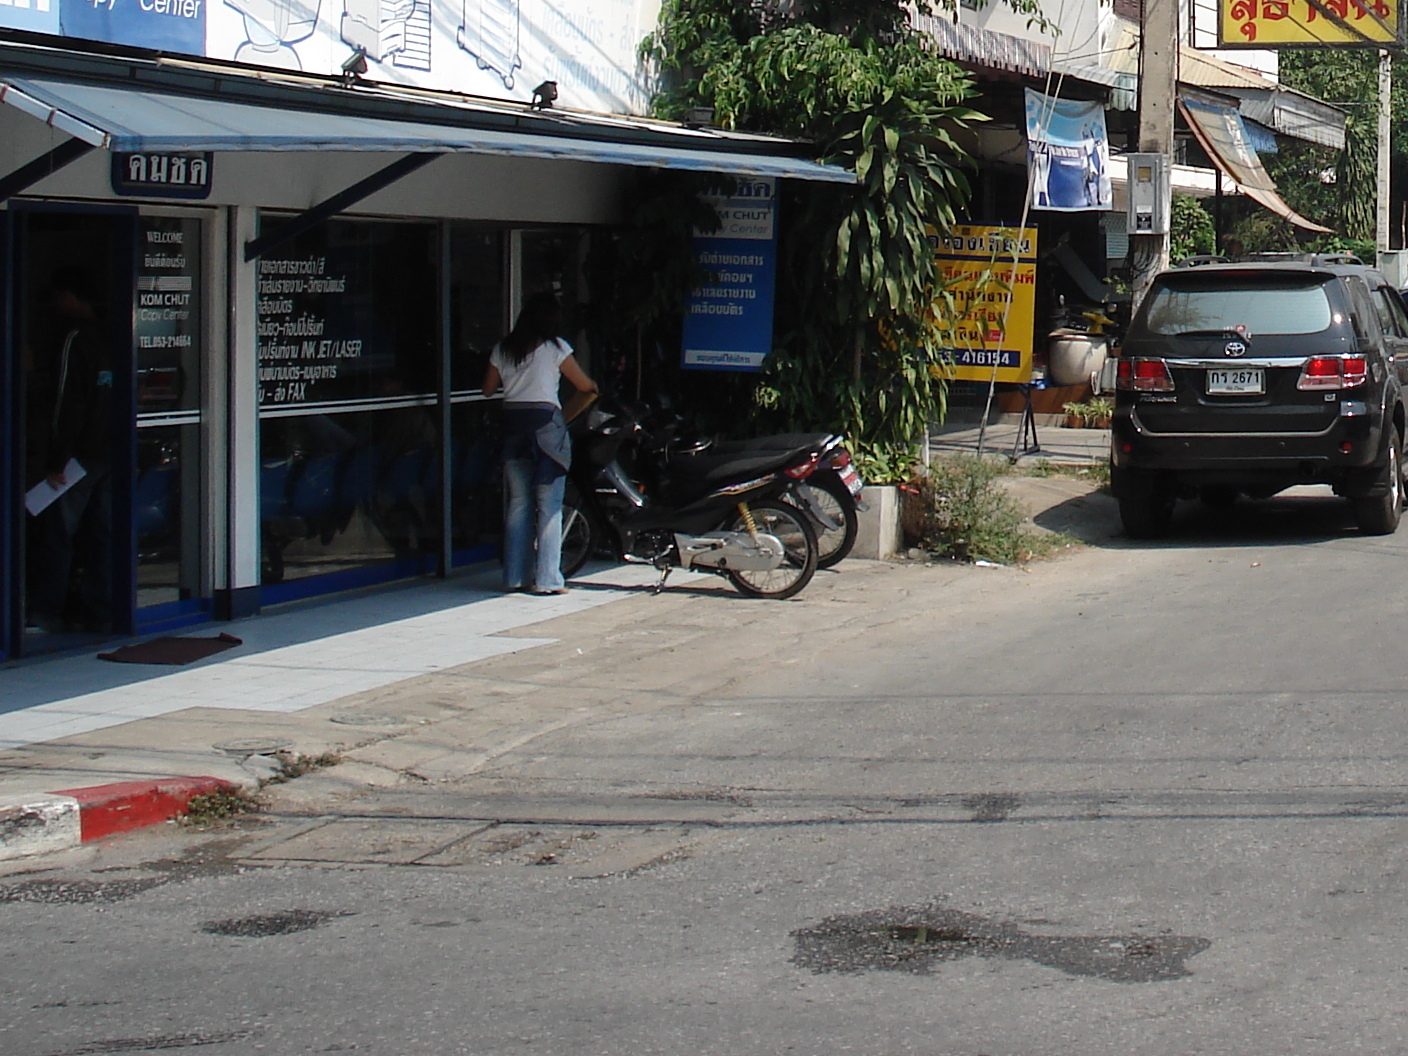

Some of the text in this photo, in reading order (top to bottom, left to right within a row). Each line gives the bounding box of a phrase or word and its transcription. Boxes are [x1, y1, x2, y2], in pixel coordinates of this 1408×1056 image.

[128, 153, 208, 186] คมชด
[733, 211, 768, 220] CHUT
[146, 231, 184, 244] WELCOME
[140, 293, 191, 306] KOM CHUT
[140, 308, 190, 322] Copy Center
[1232, 372, 1259, 384] 2671
[287, 382, 307, 401] FAX
